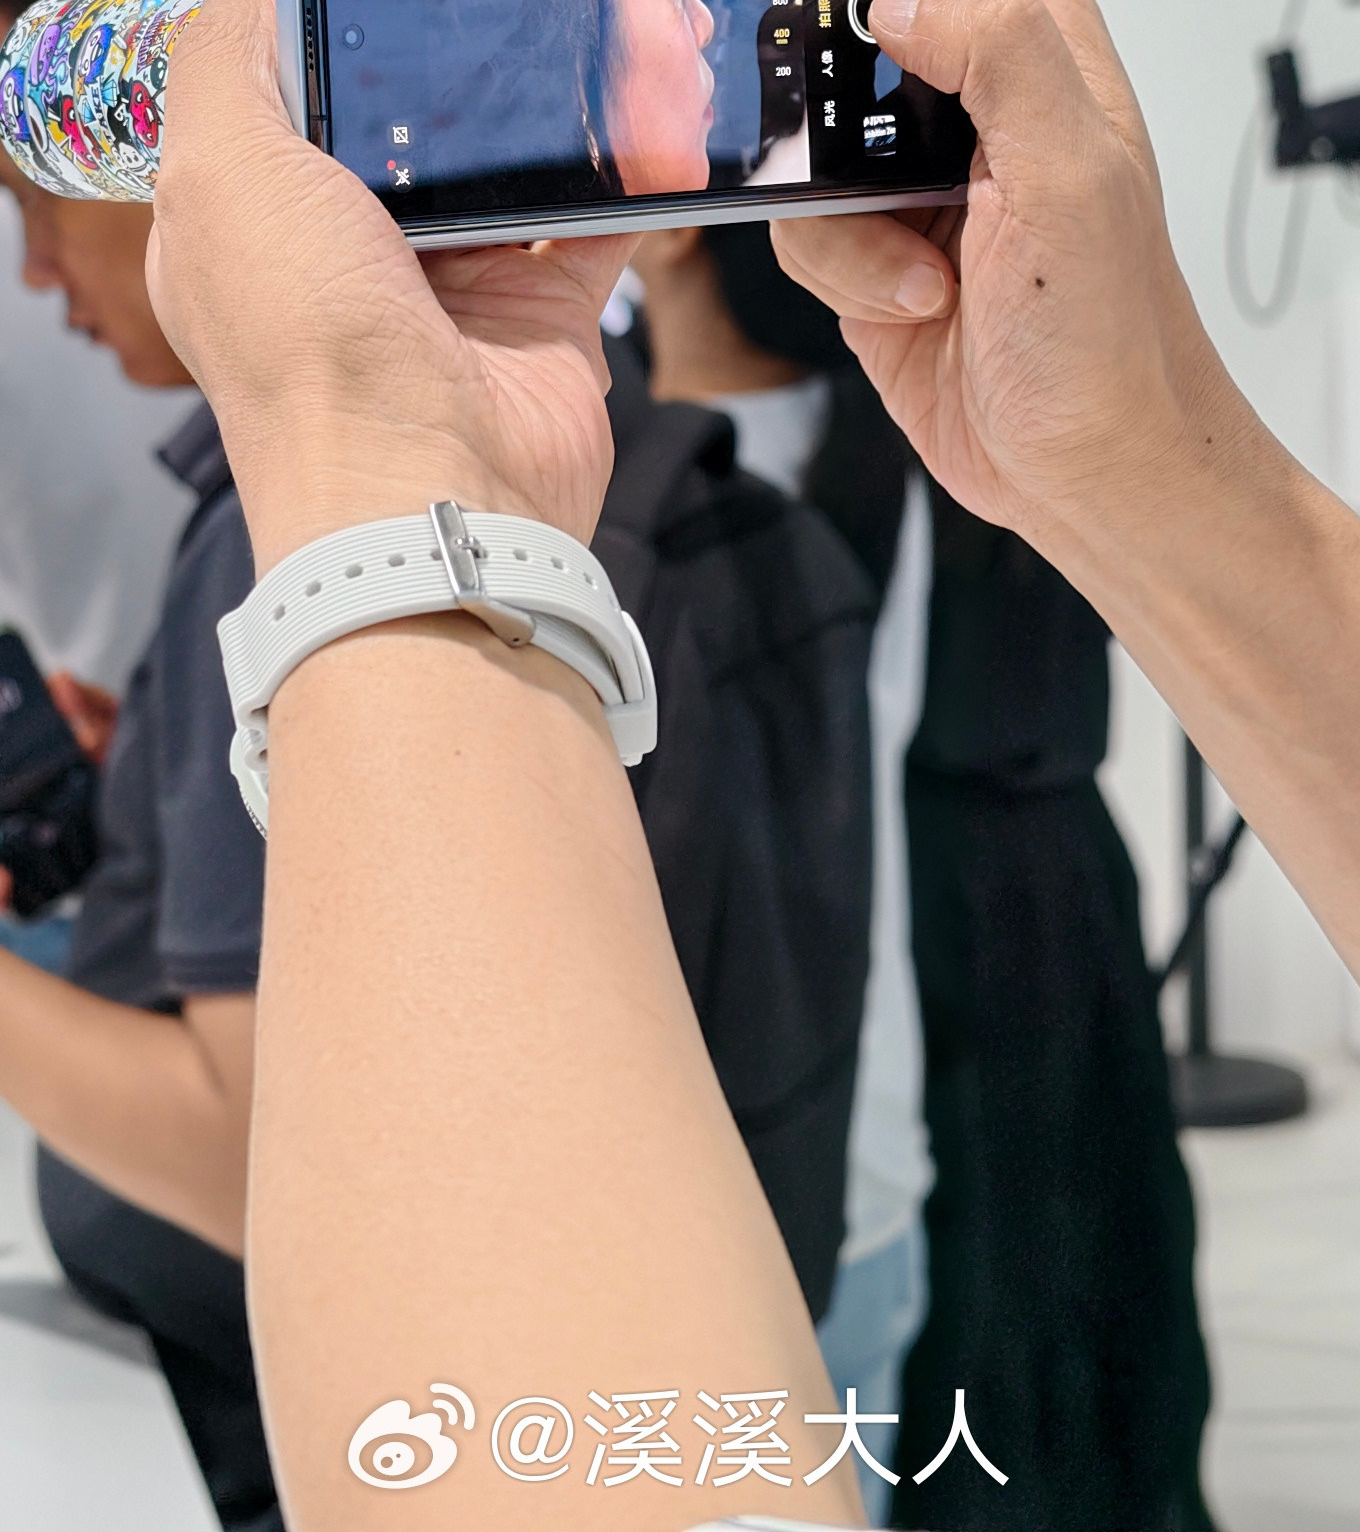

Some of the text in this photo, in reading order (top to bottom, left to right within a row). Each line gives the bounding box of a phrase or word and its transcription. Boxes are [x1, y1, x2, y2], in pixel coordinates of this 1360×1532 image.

[773, 28, 790, 39] 400
[775, 66, 791, 77] 200
[821, 50, 833, 78] 人像
[824, 100, 836, 127] 风光
